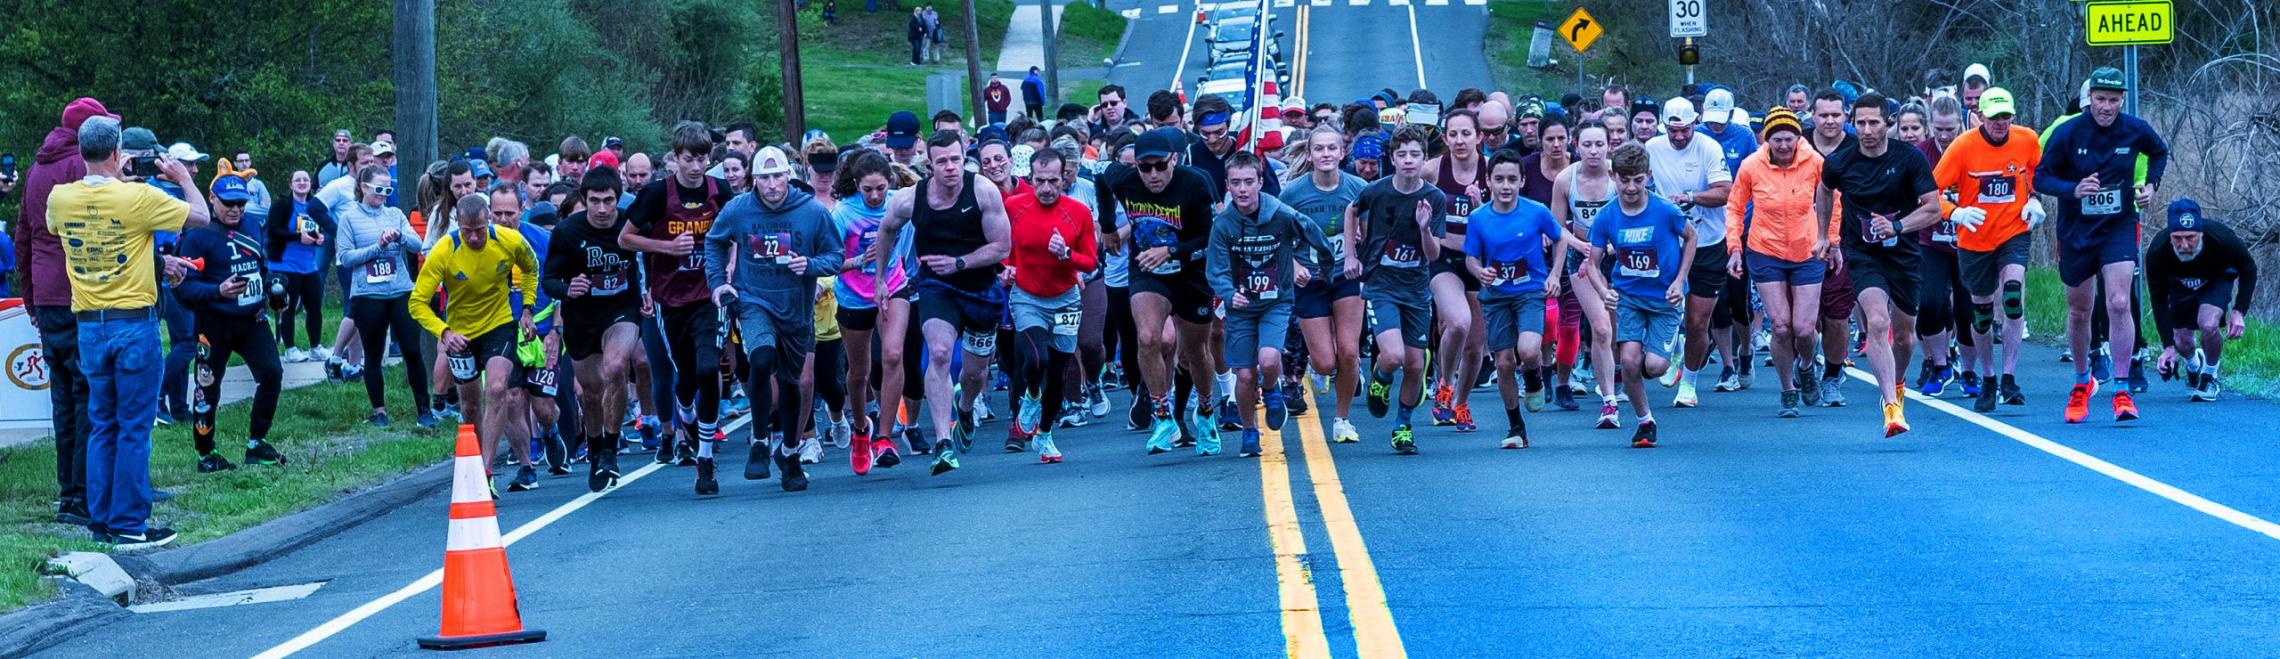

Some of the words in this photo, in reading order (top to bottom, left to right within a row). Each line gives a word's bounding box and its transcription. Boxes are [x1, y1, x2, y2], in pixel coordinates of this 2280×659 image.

[1676, 1, 1699, 17] 30
[2098, 13, 2162, 32] AHEAD
[1987, 182, 2009, 195] 180
[2088, 192, 2114, 206] 806
[227, 241, 242, 260] 1
[764, 240, 780, 256] 22
[1394, 248, 1416, 261] 161
[373, 262, 392, 275] 188
[1628, 255, 1650, 269] 169
[1501, 266, 1516, 279] 37
[603, 277, 618, 290] 82
[1247, 276, 1270, 291] 199
[968, 336, 993, 348] 866
[535, 369, 555, 385] 128
